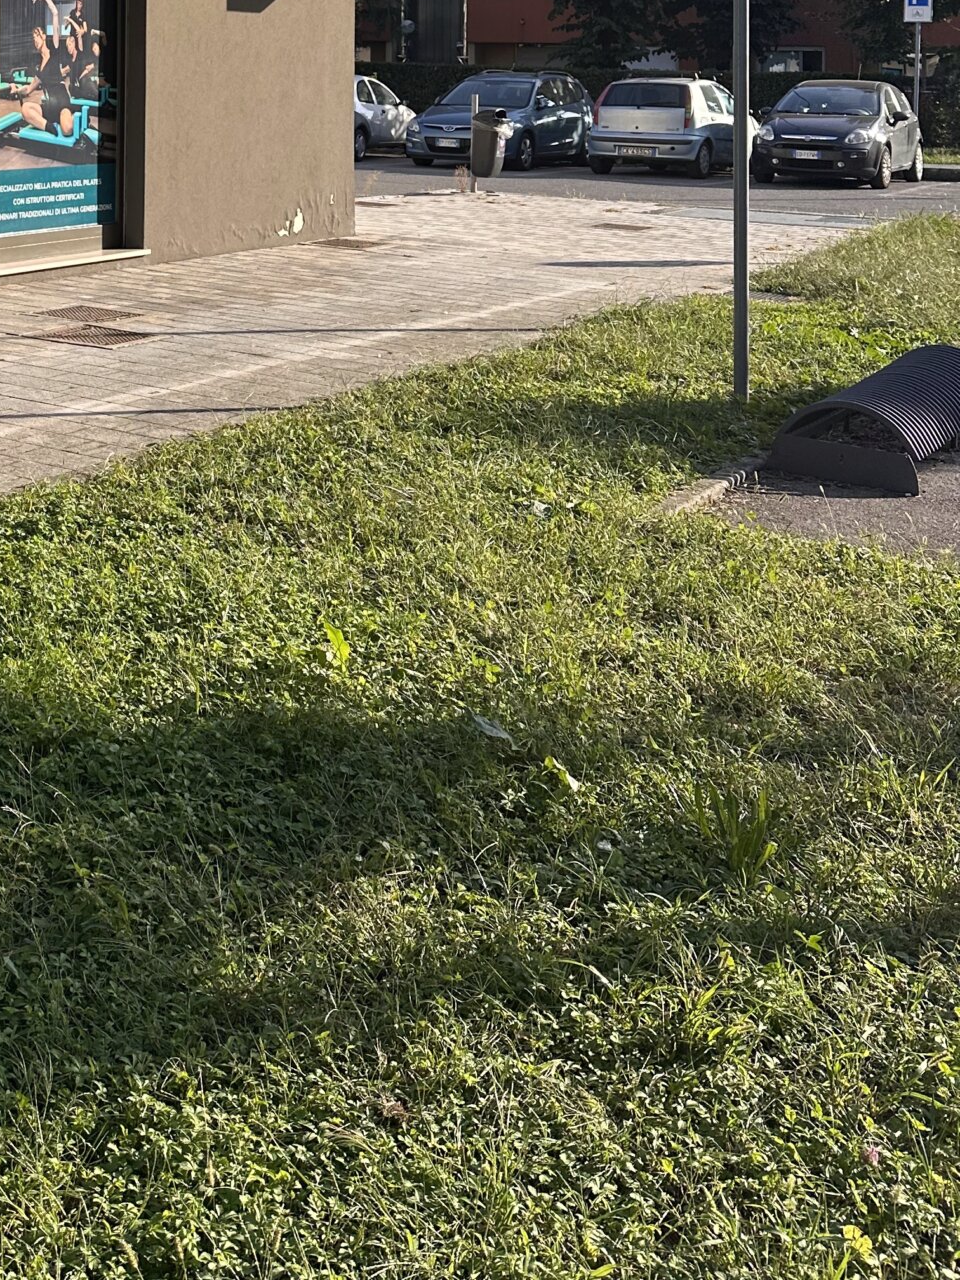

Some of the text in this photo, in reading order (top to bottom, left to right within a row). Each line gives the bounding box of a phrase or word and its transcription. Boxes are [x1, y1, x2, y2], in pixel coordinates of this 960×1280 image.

[34, 182, 50, 190] NELLA
[51, 180, 72, 188] PRATICA
[73, 179, 82, 187] DEL
[12, 193, 84, 206] CON ISTRUTTORI CERTIFICATI
[19, 209, 54, 218] TRADIZIONALI
[61, 206, 79, 214] ULTIMA
